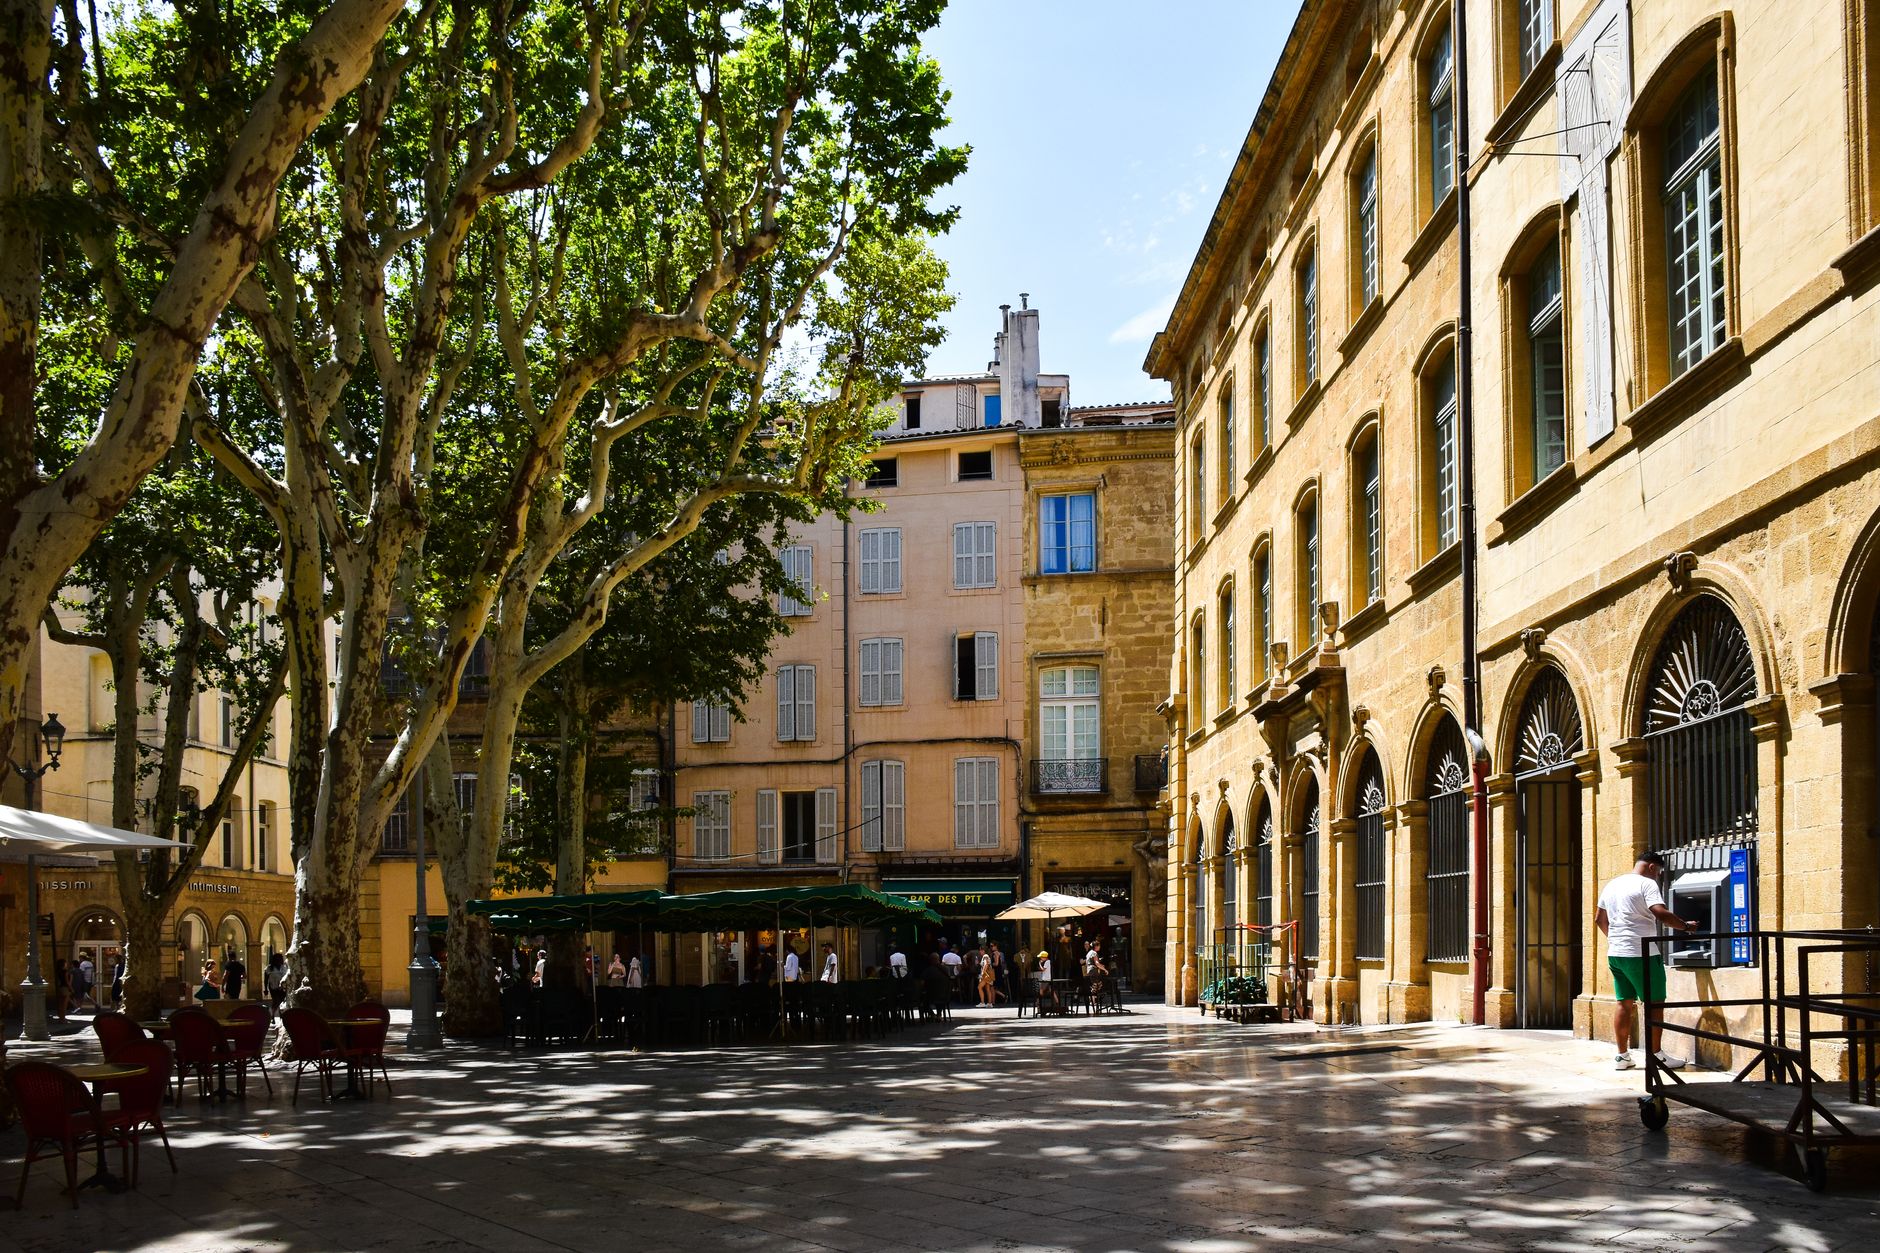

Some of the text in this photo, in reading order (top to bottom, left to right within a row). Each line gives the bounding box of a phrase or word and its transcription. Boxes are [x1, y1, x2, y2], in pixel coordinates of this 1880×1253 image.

[188, 882, 241, 894] intimissimi
[910, 894, 983, 904] BAR DES PTT
